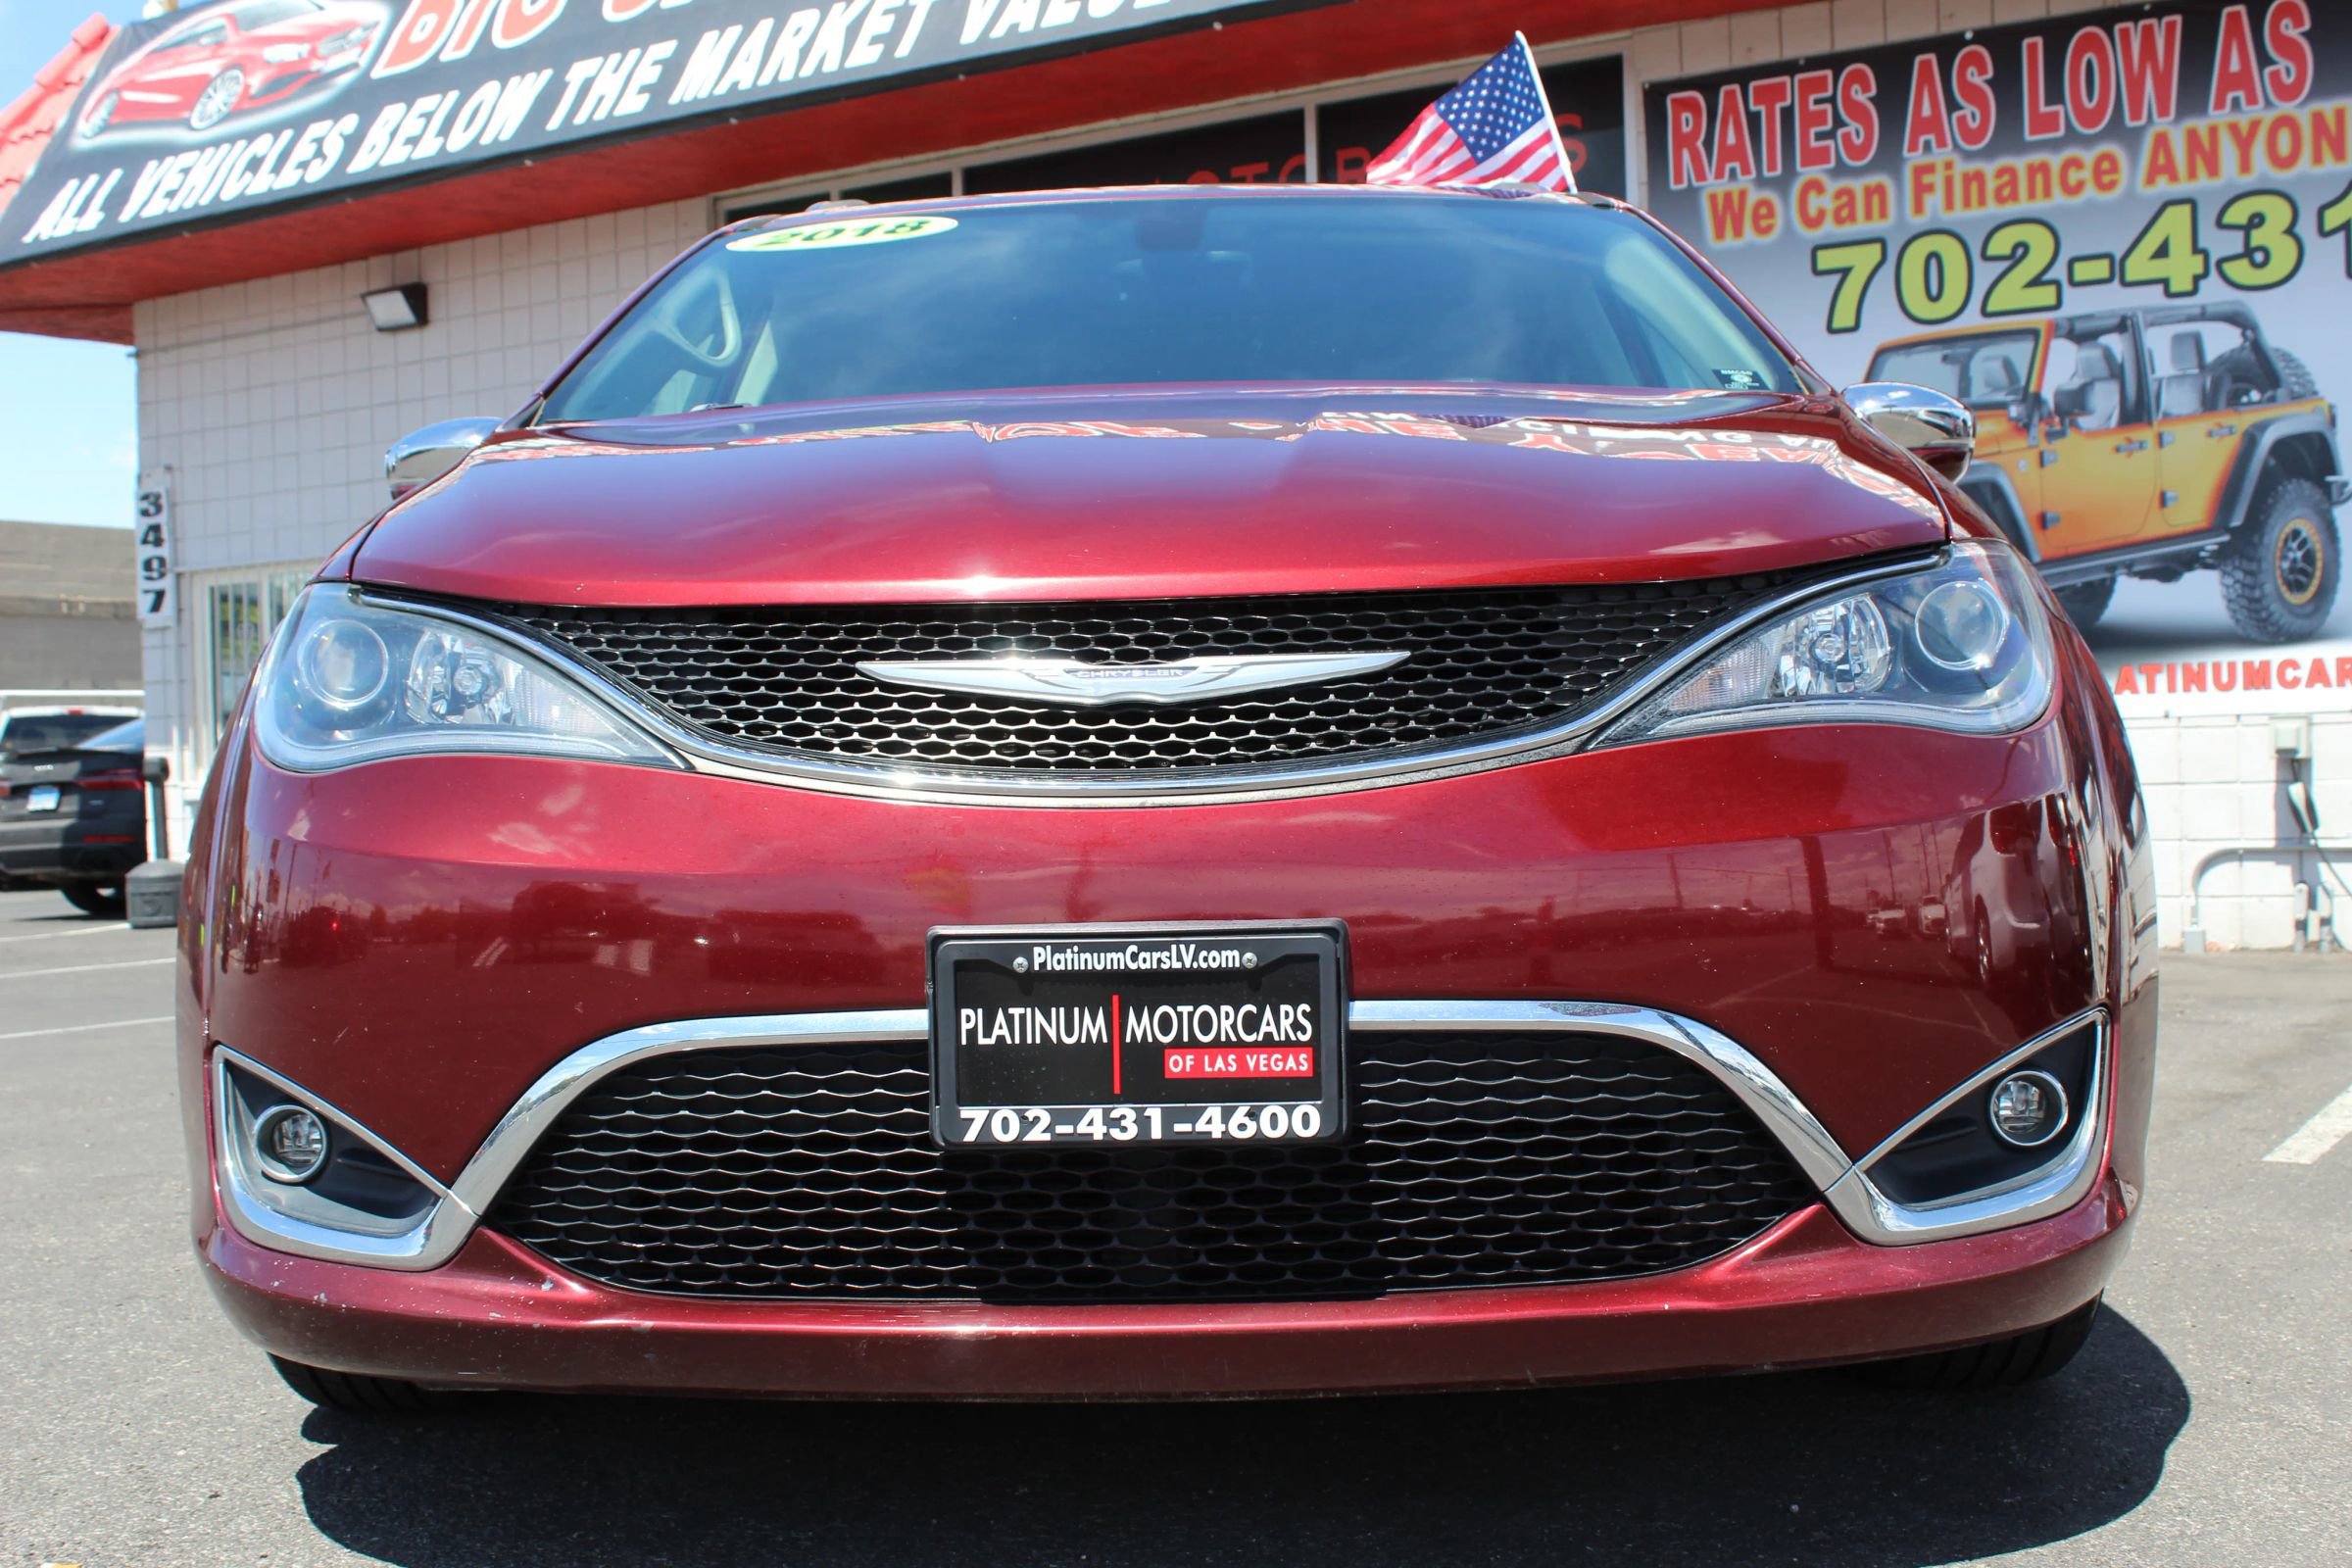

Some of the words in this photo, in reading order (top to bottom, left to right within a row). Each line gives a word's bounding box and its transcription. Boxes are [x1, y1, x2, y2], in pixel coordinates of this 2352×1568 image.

[1666, 63, 1880, 189] RATES
[1903, 45, 1996, 158] AS
[2022, 15, 2182, 141] LOW
[2209, 0, 2313, 115] AS
[22, 168, 123, 244] ALL
[118, 113, 360, 224] VEHICLES
[347, 68, 553, 175] BELOW
[545, 39, 678, 131] THE
[667, 0, 933, 105] MARKET
[1708, 188, 1778, 242] We
[1795, 176, 1891, 231] Can
[1909, 149, 2122, 218] Finance
[754, 219, 931, 247] 2018
[1077, 667, 1186, 680] CHRYSLER
[1033, 945, 1241, 972] PlatinumCarsLV.com
[960, 1005, 1108, 1045] PLATINUM
[1125, 1004, 1313, 1043] MOTORCARS
[1169, 1054, 1195, 1073] OF
[1204, 1054, 1238, 1072] LAS
[1246, 1053, 1309, 1072] VEGAS
[959, 1103, 1322, 1143] 702-431-4600
